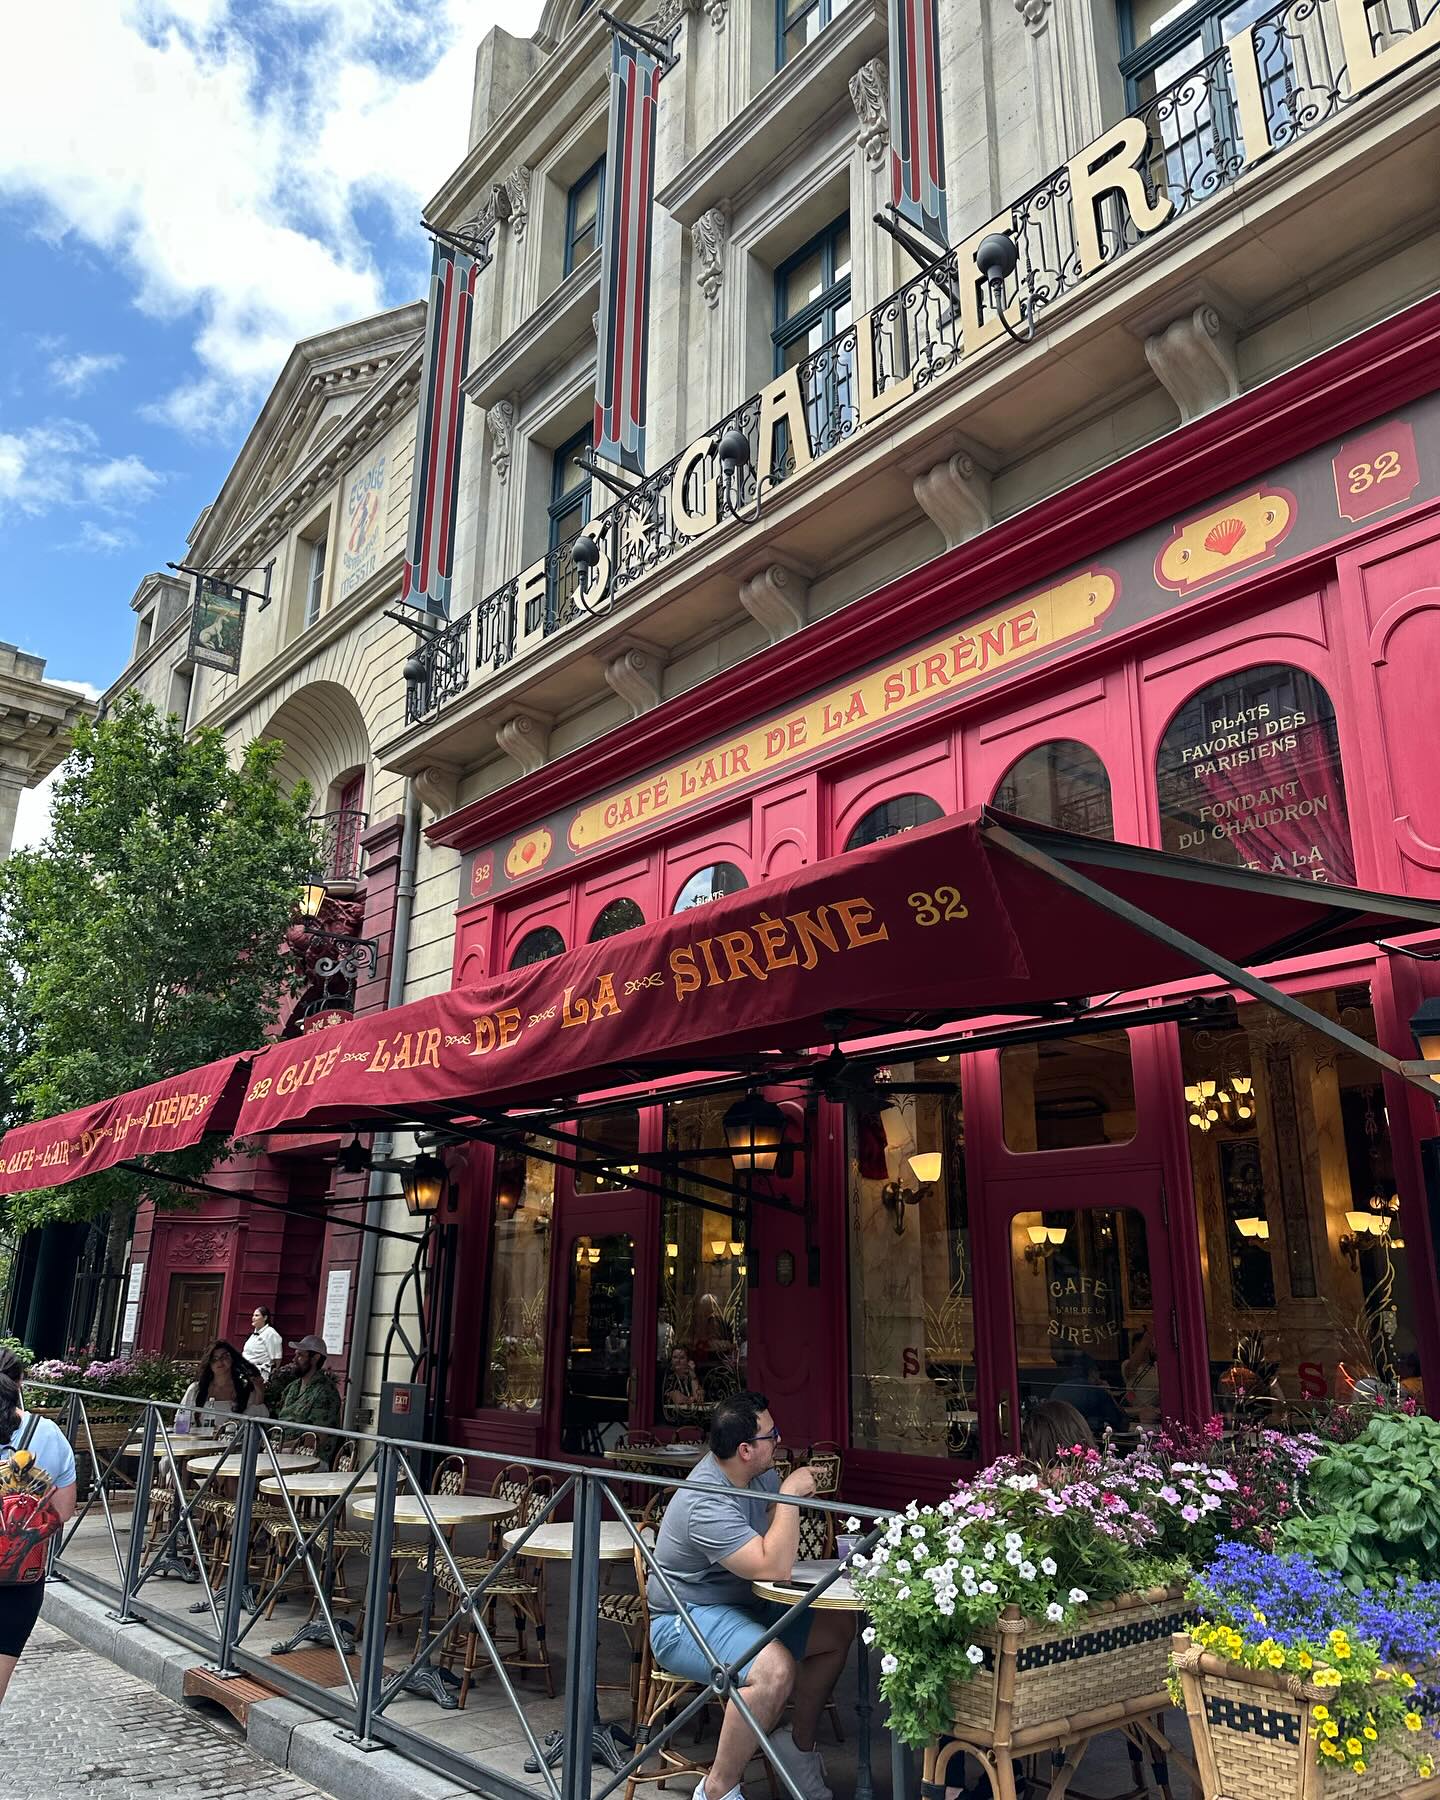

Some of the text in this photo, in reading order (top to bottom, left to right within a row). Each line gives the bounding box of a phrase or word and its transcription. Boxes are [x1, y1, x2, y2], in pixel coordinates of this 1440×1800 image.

[1348, 451, 1401, 494] 32
[469, 519, 611, 686] LES
[604, 609, 1041, 829] CAFÉ L'AIR DE LA SIRÈNE
[1182, 711, 1307, 763] FAVORIS DES
[1211, 703, 1270, 734] PLATS
[1193, 735, 1298, 779] PARISIENS
[1178, 795, 1329, 850] DU CHAUDRON
[1199, 781, 1300, 823] FONDANT
[475, 864, 490, 883] 32
[1292, 845, 1325, 868] LA
[247, 1077, 273, 1102] 32
[365, 1028, 442, 1072] L'AIR
[468, 1007, 523, 1057] DE
[561, 972, 622, 1030] LA
[669, 897, 889, 1001] SIRÈNE
[907, 886, 970, 927] 32
[903, 1347, 920, 1379] S
[1298, 1361, 1328, 1400] S
[394, 1395, 409, 1405] EXIT
